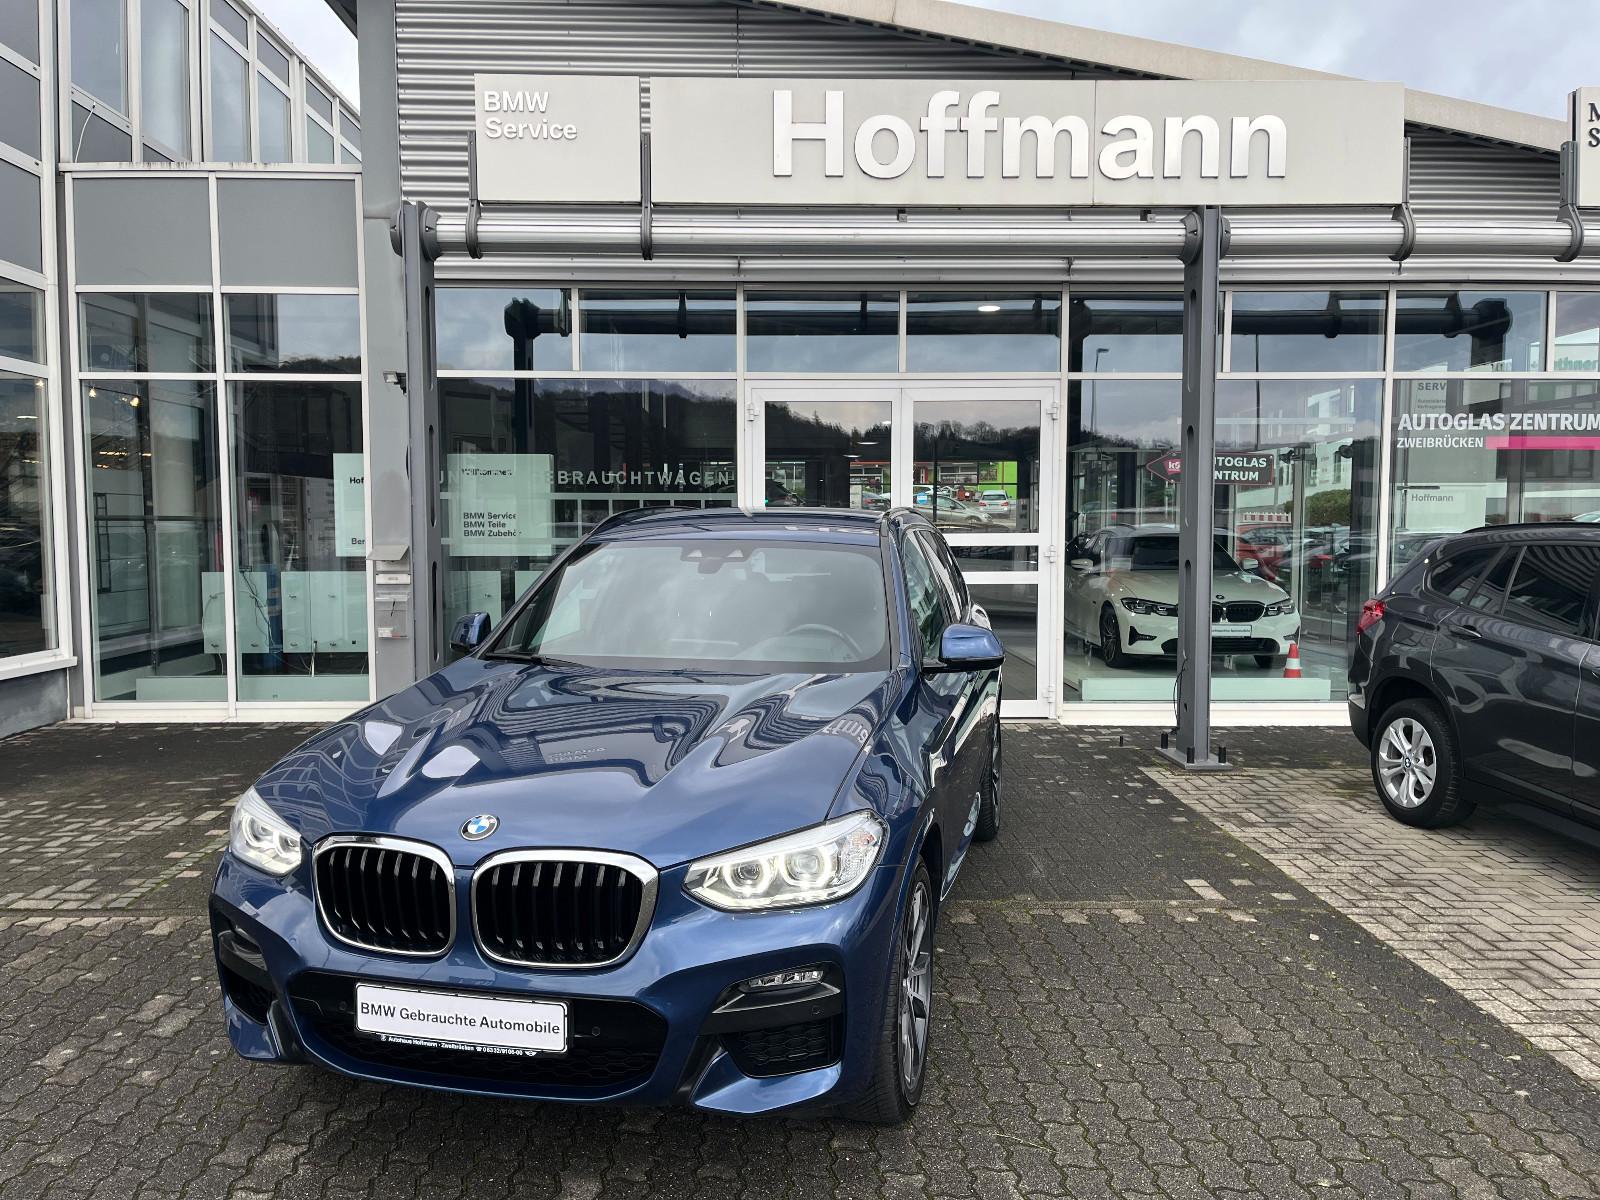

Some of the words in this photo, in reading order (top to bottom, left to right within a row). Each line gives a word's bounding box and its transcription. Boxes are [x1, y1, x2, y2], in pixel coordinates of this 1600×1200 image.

[484, 91, 549, 113] BMW
[485, 117, 578, 140] Service
[772, 90, 1288, 179] Hoffmann
[1397, 412, 1506, 431] AUTOGLAS
[1509, 412, 1600, 431] ZENTRUM
[1396, 434, 1484, 449] ZWEIBRÜCKEN
[1214, 456, 1267, 468] TOGLAS
[1410, 493, 1454, 502] Hoffmann
[463, 512, 485, 520] BMW
[463, 521, 485, 529] BMW
[487, 521, 507, 529] Teile
[463, 529, 486, 537] BMW
[487, 529, 522, 537] Zubehö
[360, 1002, 396, 1018] BMW
[399, 1007, 477, 1027] Gebrauchte
[479, 1016, 560, 1034] Automobile
